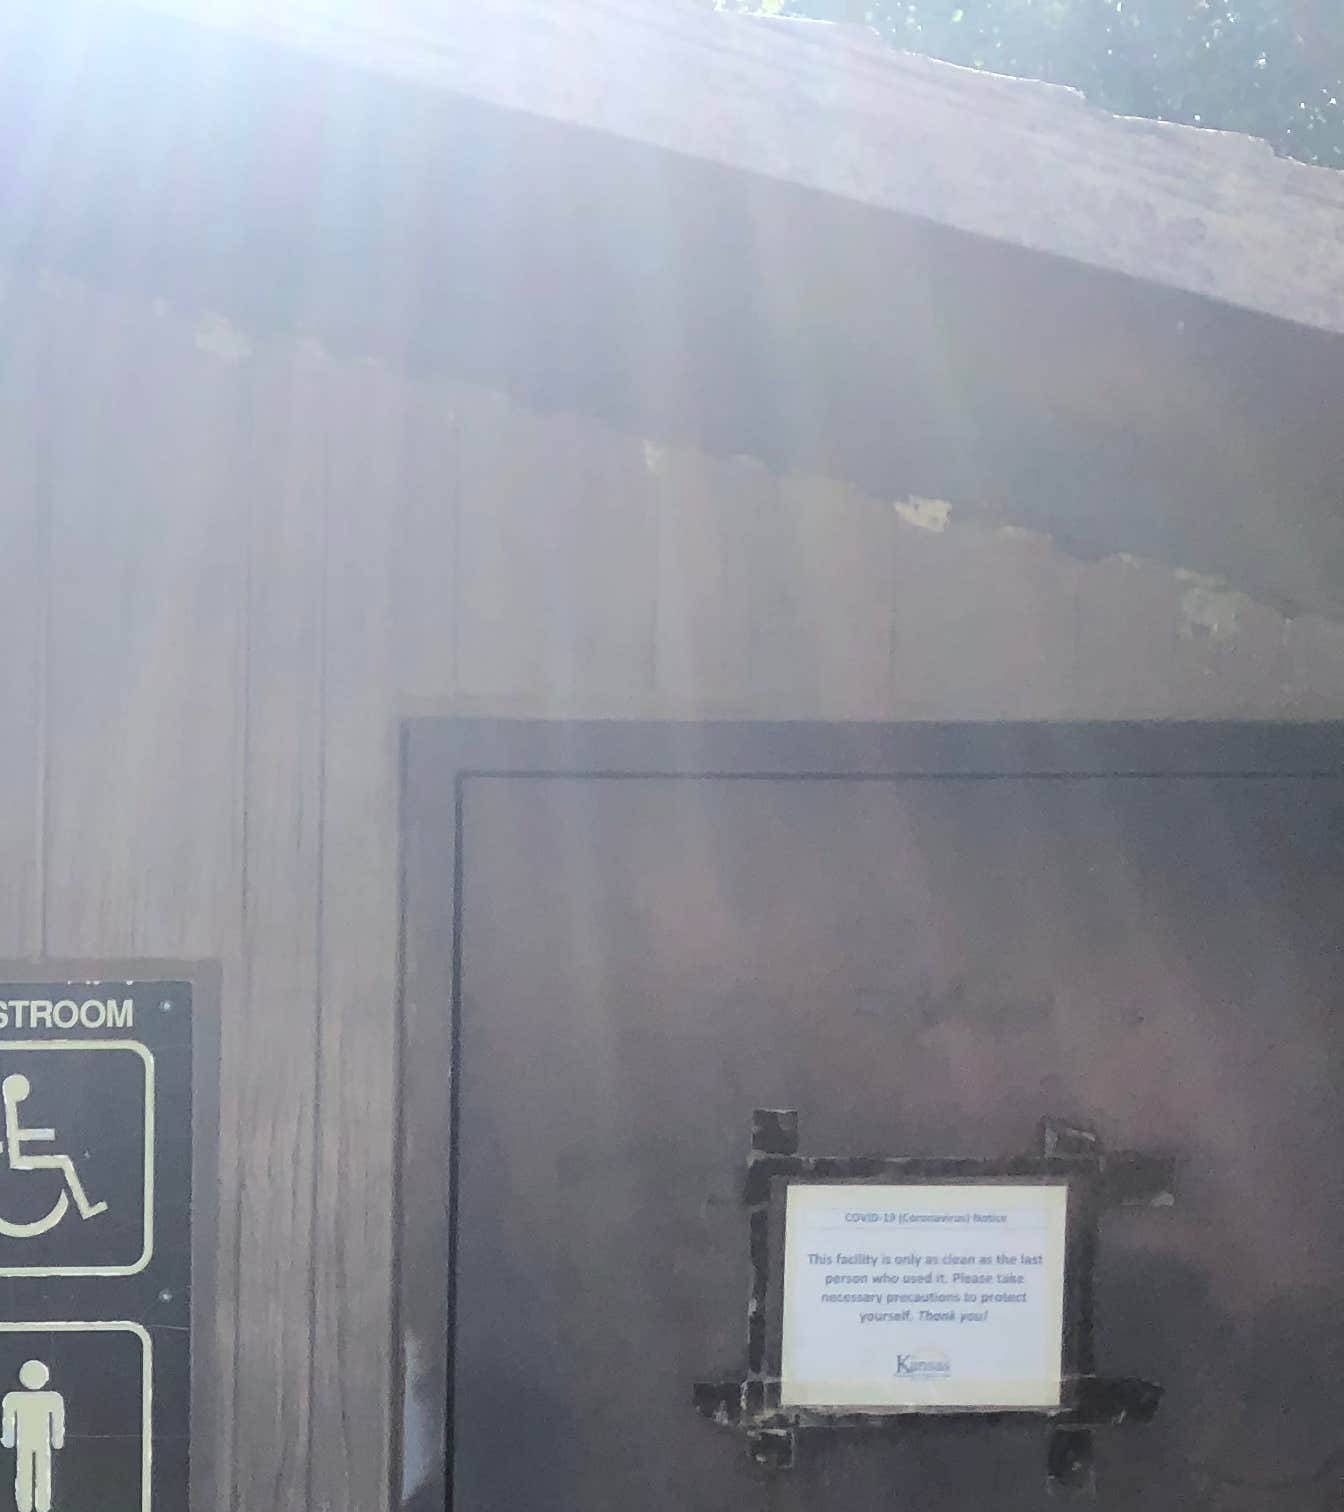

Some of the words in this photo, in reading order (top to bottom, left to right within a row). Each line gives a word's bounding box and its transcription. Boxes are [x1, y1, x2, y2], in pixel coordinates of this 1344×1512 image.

[845, 1212, 896, 1223] COVID-19
[973, 1213, 1007, 1223] Notice
[808, 1254, 832, 1265] This
[836, 1254, 877, 1267] facility
[882, 1254, 891, 1265] is
[895, 1254, 921, 1267] only
[926, 1256, 938, 1265] as
[942, 1254, 975, 1265] clean
[979, 1256, 992, 1265] as
[996, 1254, 1017, 1265] the
[1020, 1254, 1043, 1265] last
[825, 1275, 867, 1286] person
[872, 1272, 899, 1284] who
[903, 1272, 932, 1284] used
[953, 1273, 992, 1284] Please
[997, 1273, 1024, 1284] take
[821, 1293, 881, 1304] necessary
[887, 1292, 960, 1304] precautions
[964, 1292, 976, 1302] to
[981, 1292, 1027, 1304] protect
[919, 1310, 955, 1321] Thank
[961, 1310, 988, 1323] you!
